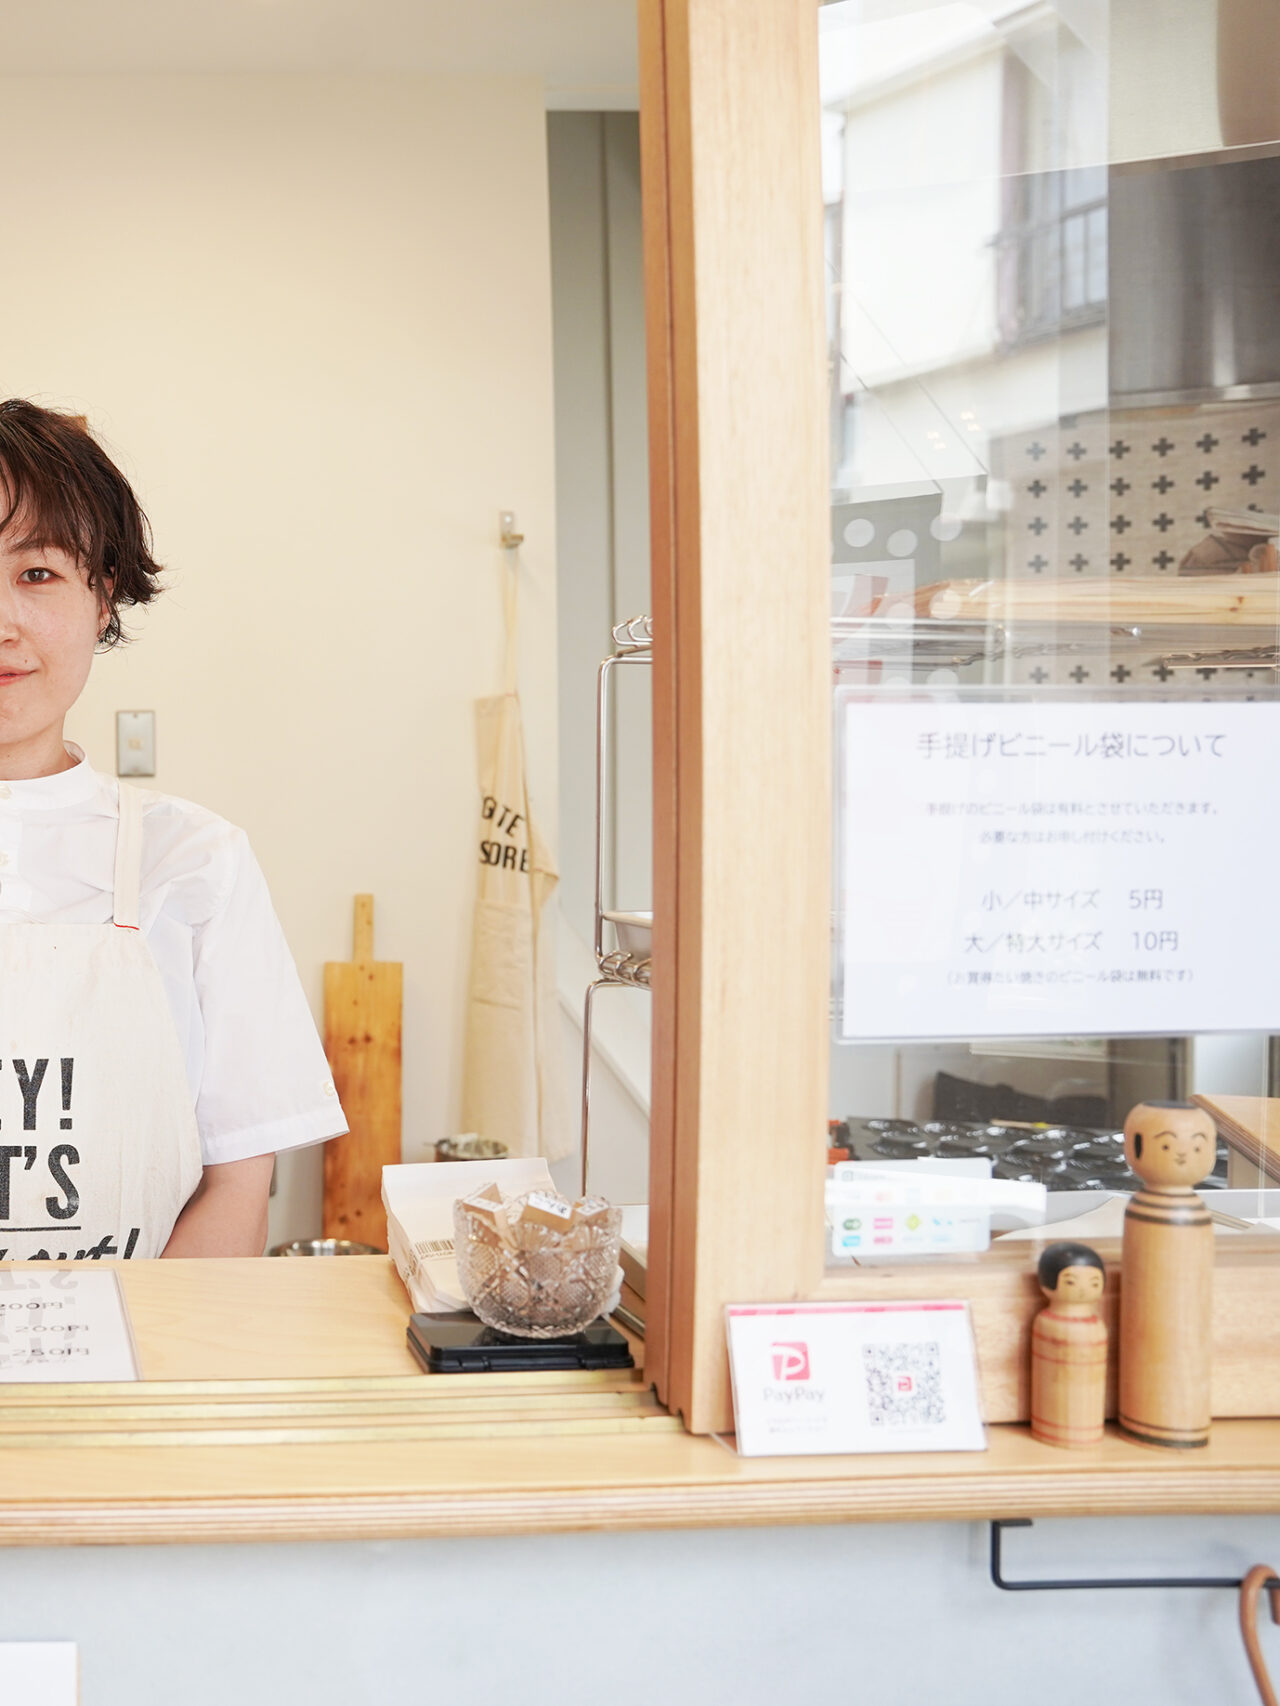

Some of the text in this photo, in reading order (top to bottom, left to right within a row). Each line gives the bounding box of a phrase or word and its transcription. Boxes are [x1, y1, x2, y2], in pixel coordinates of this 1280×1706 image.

[916, 731, 1228, 760] 手提げビニール袋について
[1128, 888, 1165, 911] 5円
[1131, 930, 1179, 952] 10円
[762, 1385, 825, 1404] PayPay
